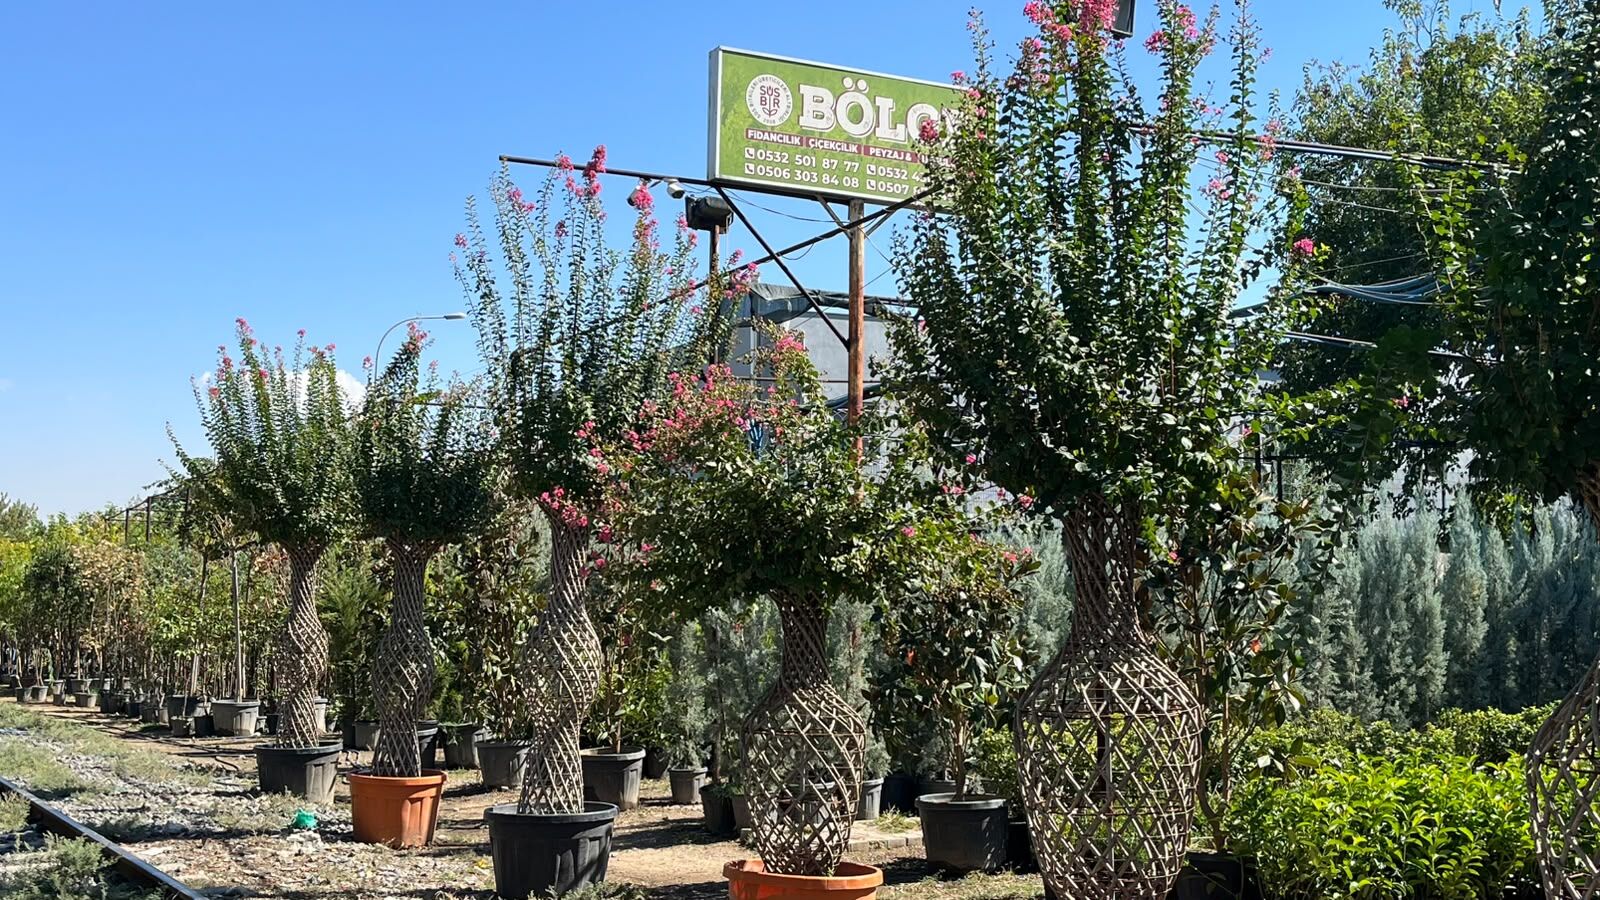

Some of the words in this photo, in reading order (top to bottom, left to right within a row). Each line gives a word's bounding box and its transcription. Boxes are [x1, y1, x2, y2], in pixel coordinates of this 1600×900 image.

[757, 149, 789, 164] 0532
[795, 154, 816, 168] 501
[822, 158, 839, 170] 87
[843, 160, 860, 173] 77
[869, 147, 904, 160] PEYZAJ
[757, 165, 791, 179] 0506
[794, 169, 818, 183] 303
[822, 173, 839, 186] 84
[842, 176, 860, 188] 08
[878, 165, 908, 180] 0532
[878, 180, 909, 195] 0507
